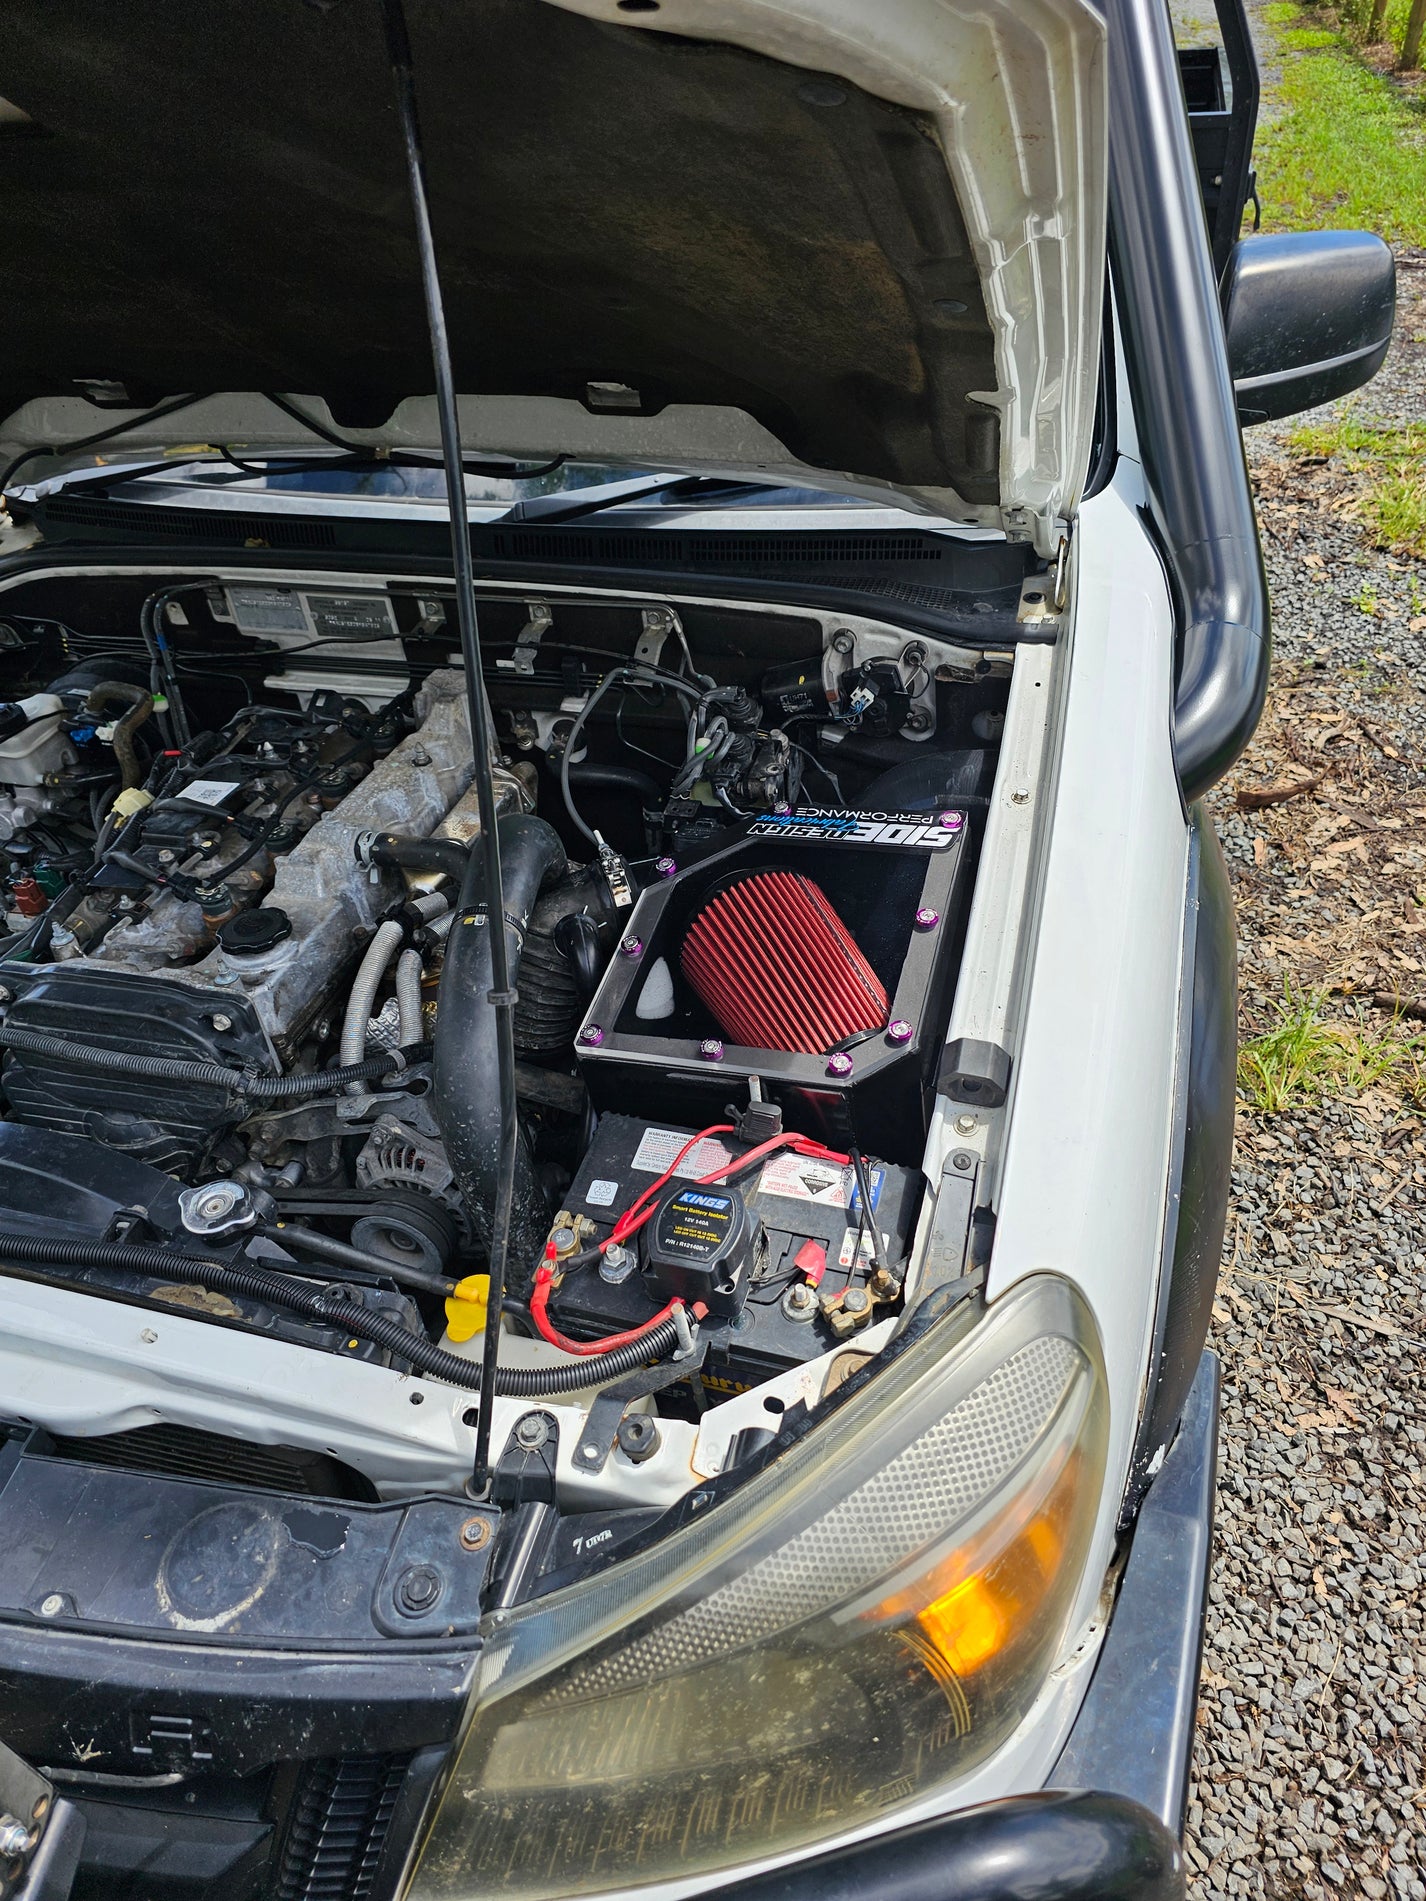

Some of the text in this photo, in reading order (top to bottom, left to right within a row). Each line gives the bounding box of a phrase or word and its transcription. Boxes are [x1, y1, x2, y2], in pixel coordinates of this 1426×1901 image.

[756, 814, 860, 831] Fabrications
[796, 807, 934, 824] PERFORMANCE
[804, 1178, 829, 1187] CORROSIVE
[679, 1192, 730, 1210] KINGS
[689, 1207, 708, 1216] Battery
[708, 1212, 728, 1220] Isolator
